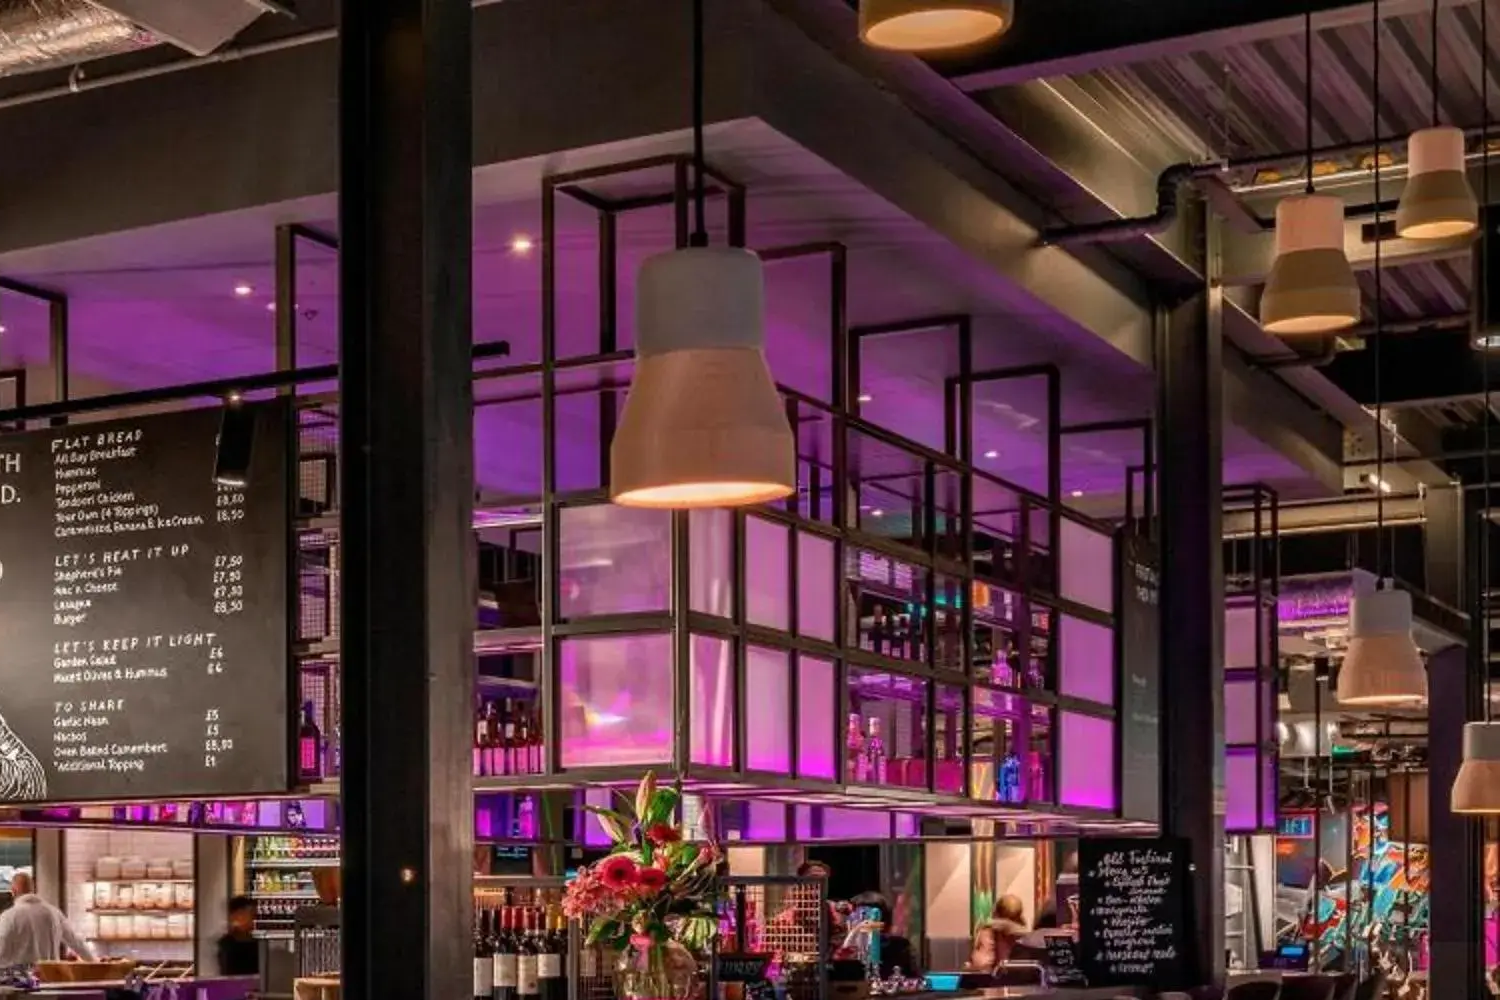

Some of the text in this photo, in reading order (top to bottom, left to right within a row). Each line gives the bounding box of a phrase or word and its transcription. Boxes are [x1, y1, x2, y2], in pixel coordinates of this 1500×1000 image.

[51, 429, 144, 453] FLAT BREAD
[70, 450, 88, 465] Day
[89, 445, 138, 462] Breakfast
[55, 467, 98, 480] Hummus
[55, 480, 101, 496] Pepperoni
[56, 491, 136, 508] Tandoori Chicken
[77, 510, 99, 521] Own
[55, 544, 189, 567] LET'S HEAT IT UP
[84, 582, 120, 594] Cheese
[53, 613, 88, 626] Burger
[54, 632, 218, 654] LET'S KEEP IT LIGHT
[53, 657, 89, 669] Garden
[54, 699, 125, 713] TO SHARE
[53, 731, 88, 742] Nachos
[111, 742, 169, 756] Camembert
